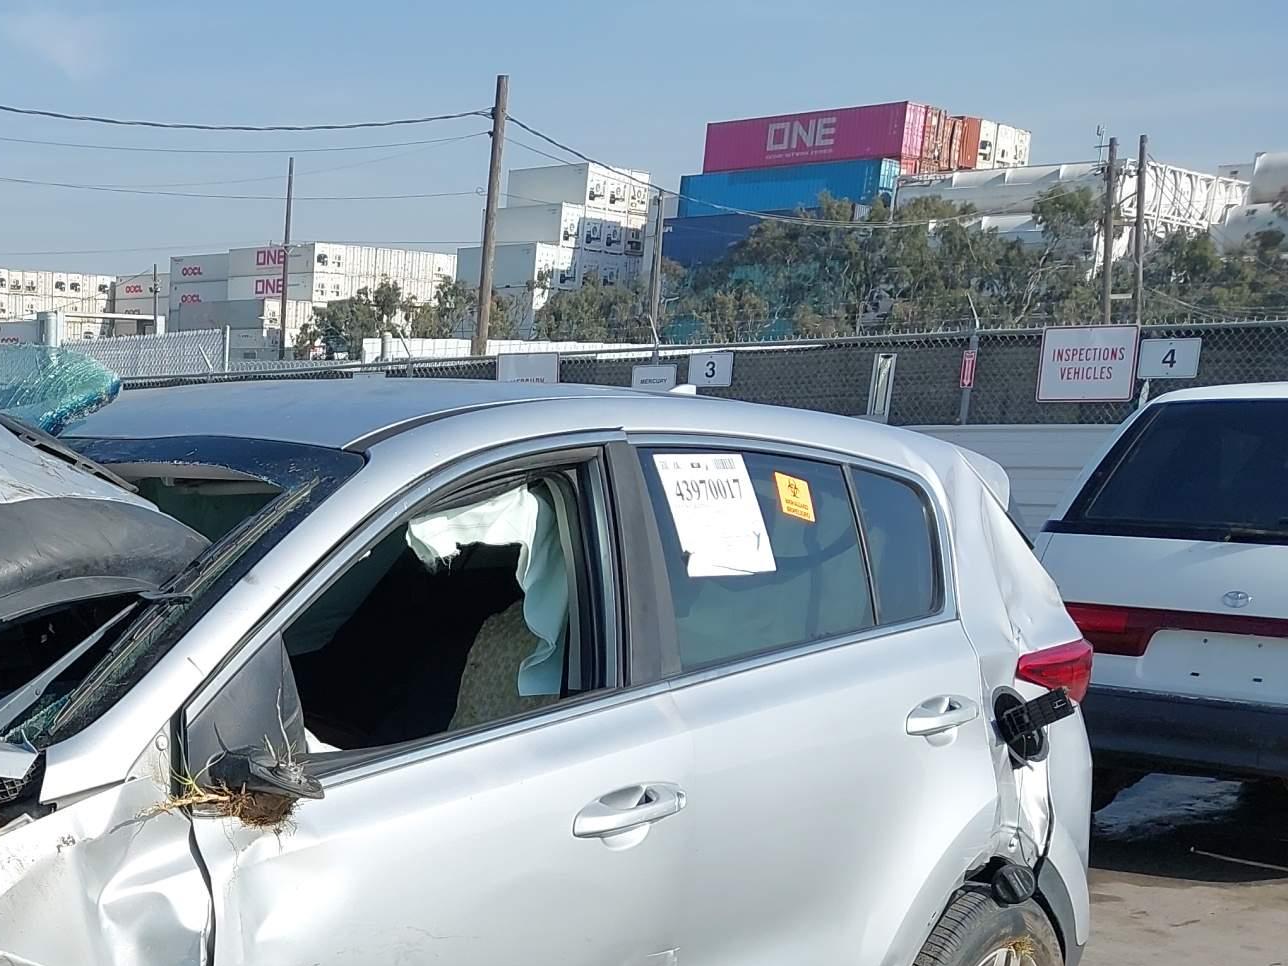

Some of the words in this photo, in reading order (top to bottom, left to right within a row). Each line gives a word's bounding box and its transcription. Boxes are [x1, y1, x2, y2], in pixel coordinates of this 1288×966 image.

[766, 117, 837, 151] ONE
[256, 249, 285, 265] ONE
[181, 267, 203, 276] OOCL
[125, 285, 143, 293] OOCL
[255, 279, 283, 295] ONE
[181, 294, 202, 303] OOCL
[1052, 346, 1126, 362] INSPECTIONS
[1161, 348, 1177, 368] 4
[705, 361, 716, 378] 3
[1060, 366, 1113, 381] VEHICLES
[675, 478, 742, 502] 43970017
